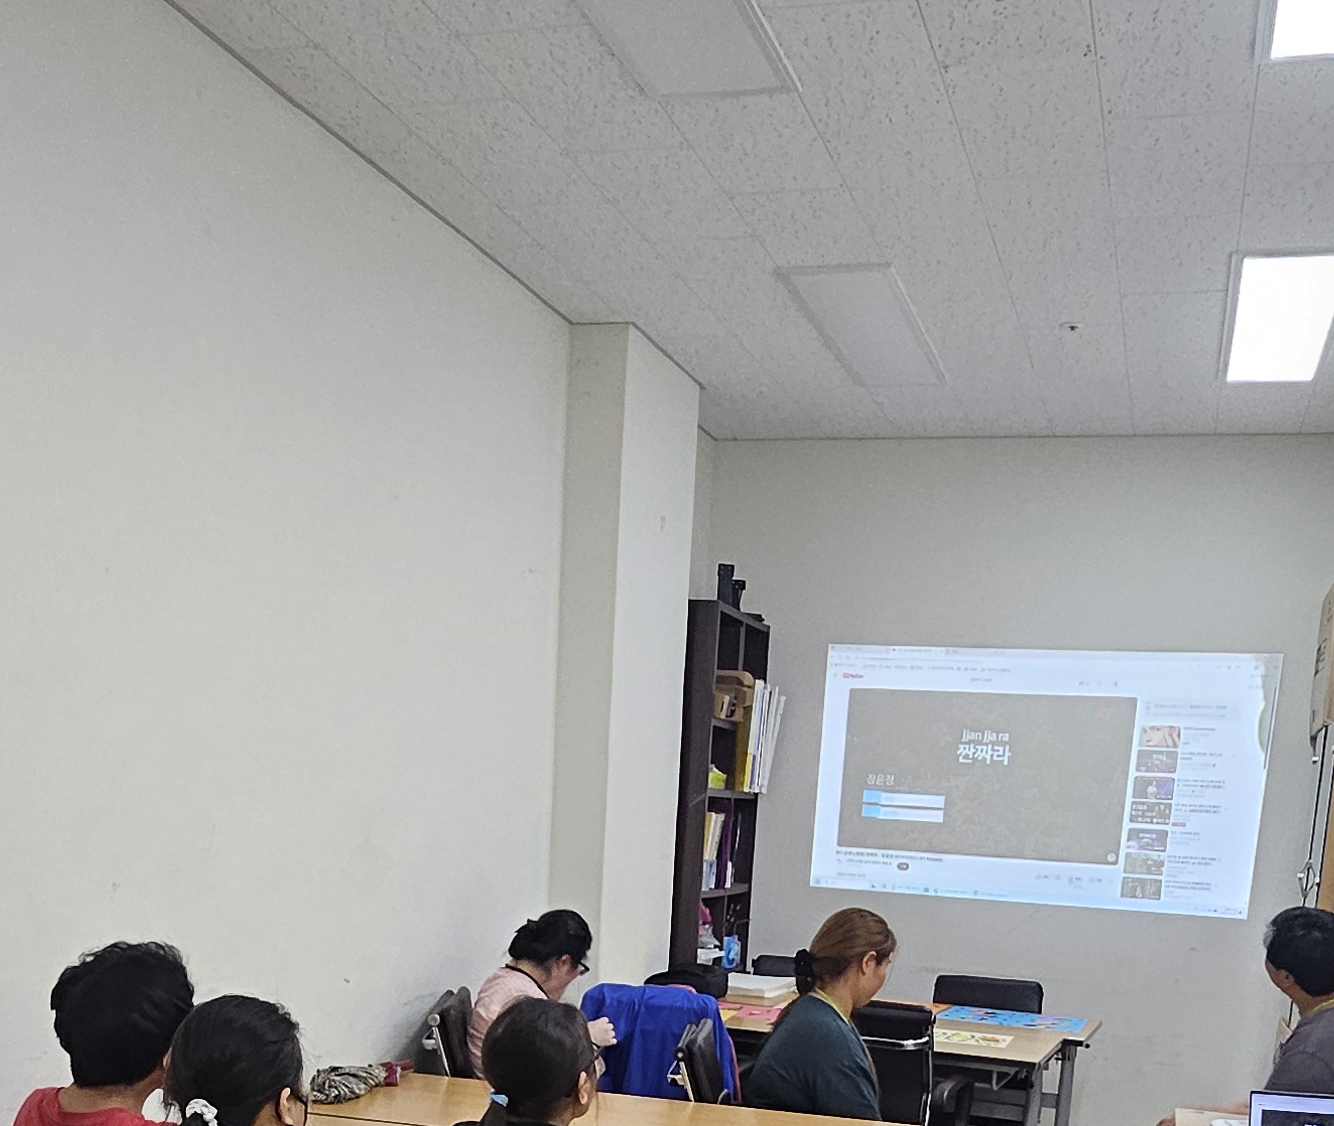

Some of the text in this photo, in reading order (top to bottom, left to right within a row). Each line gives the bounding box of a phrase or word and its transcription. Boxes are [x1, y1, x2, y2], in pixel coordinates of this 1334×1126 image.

[998, 733, 1009, 742] ra
[957, 743, 1012, 766] 짠짜라
[866, 774, 895, 786] 장윤정
